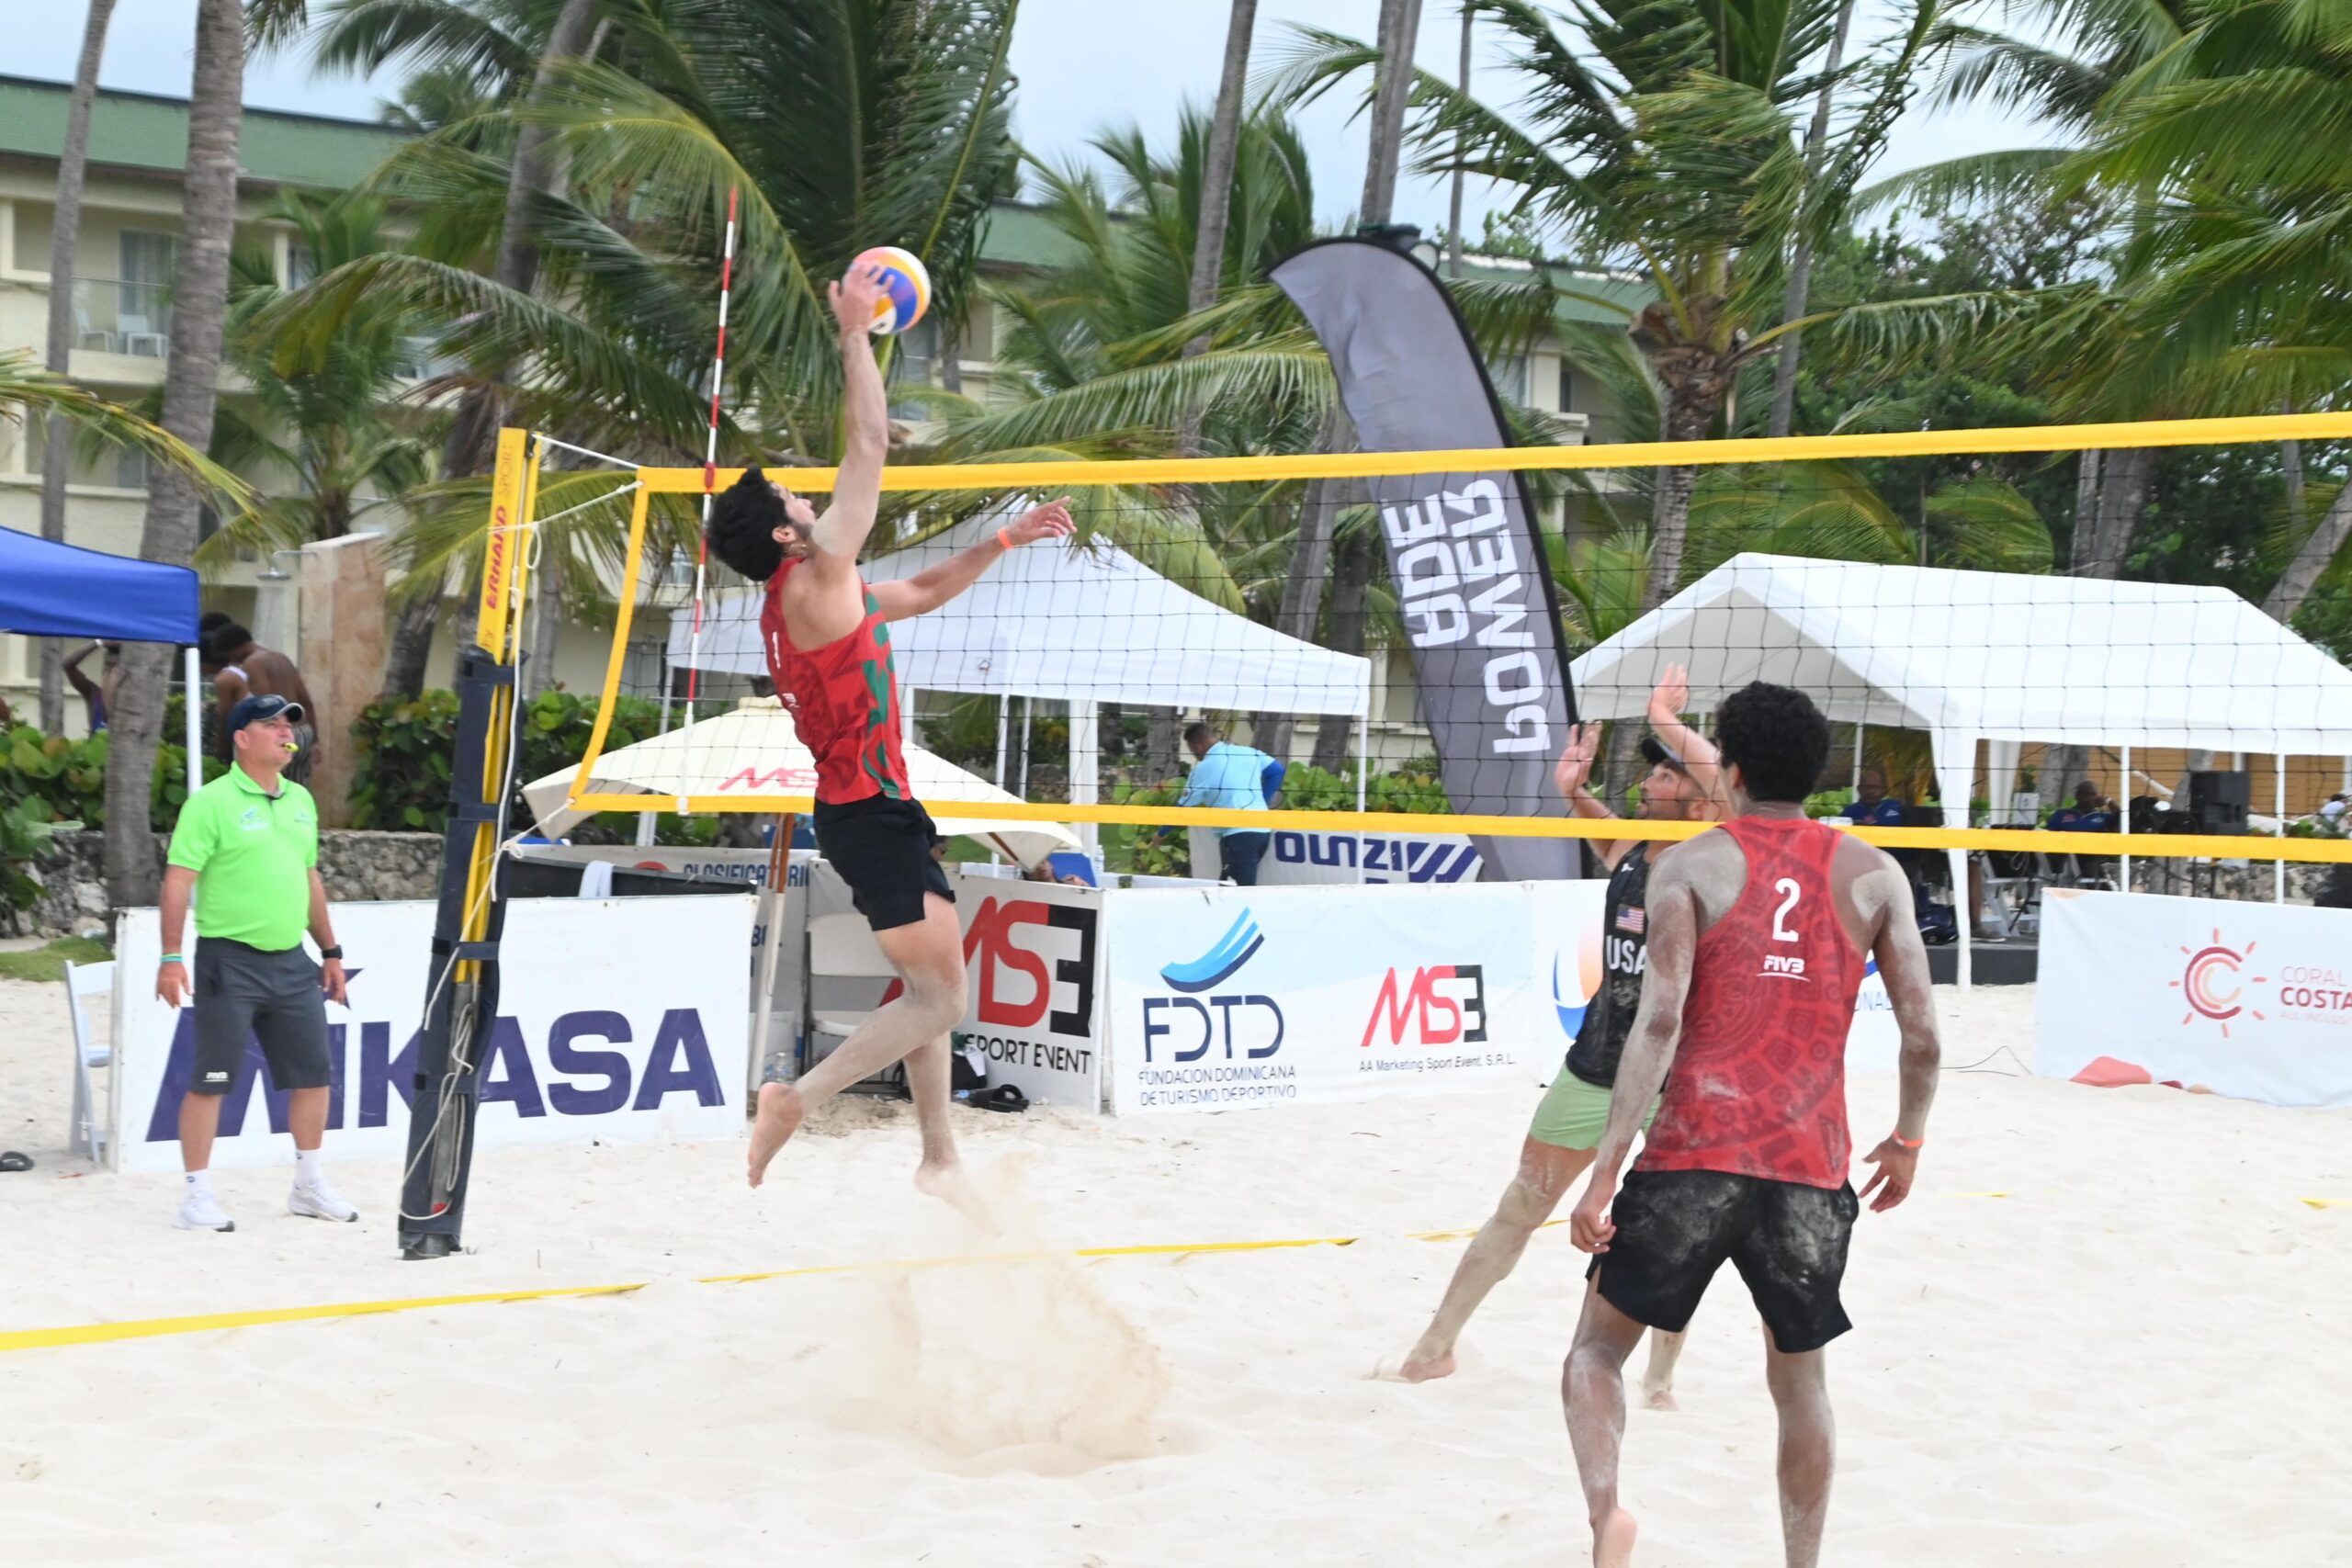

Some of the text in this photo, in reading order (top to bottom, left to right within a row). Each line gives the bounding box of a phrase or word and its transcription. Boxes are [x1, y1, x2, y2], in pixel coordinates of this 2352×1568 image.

[718, 767, 818, 790] MS
[1772, 876, 1802, 942] 2
[1606, 934, 1647, 975] USA
[2281, 965, 2347, 987] CORAL
[2280, 987, 2352, 1010] COSTA
[1142, 995, 1284, 1063] FDTD
[1034, 1043, 1091, 1074] EVENT
[1427, 1056, 1453, 1072] Sport
[1216, 1065, 1296, 1082] DOMINICANA
[1222, 1084, 1297, 1101] DEPORTIVO
